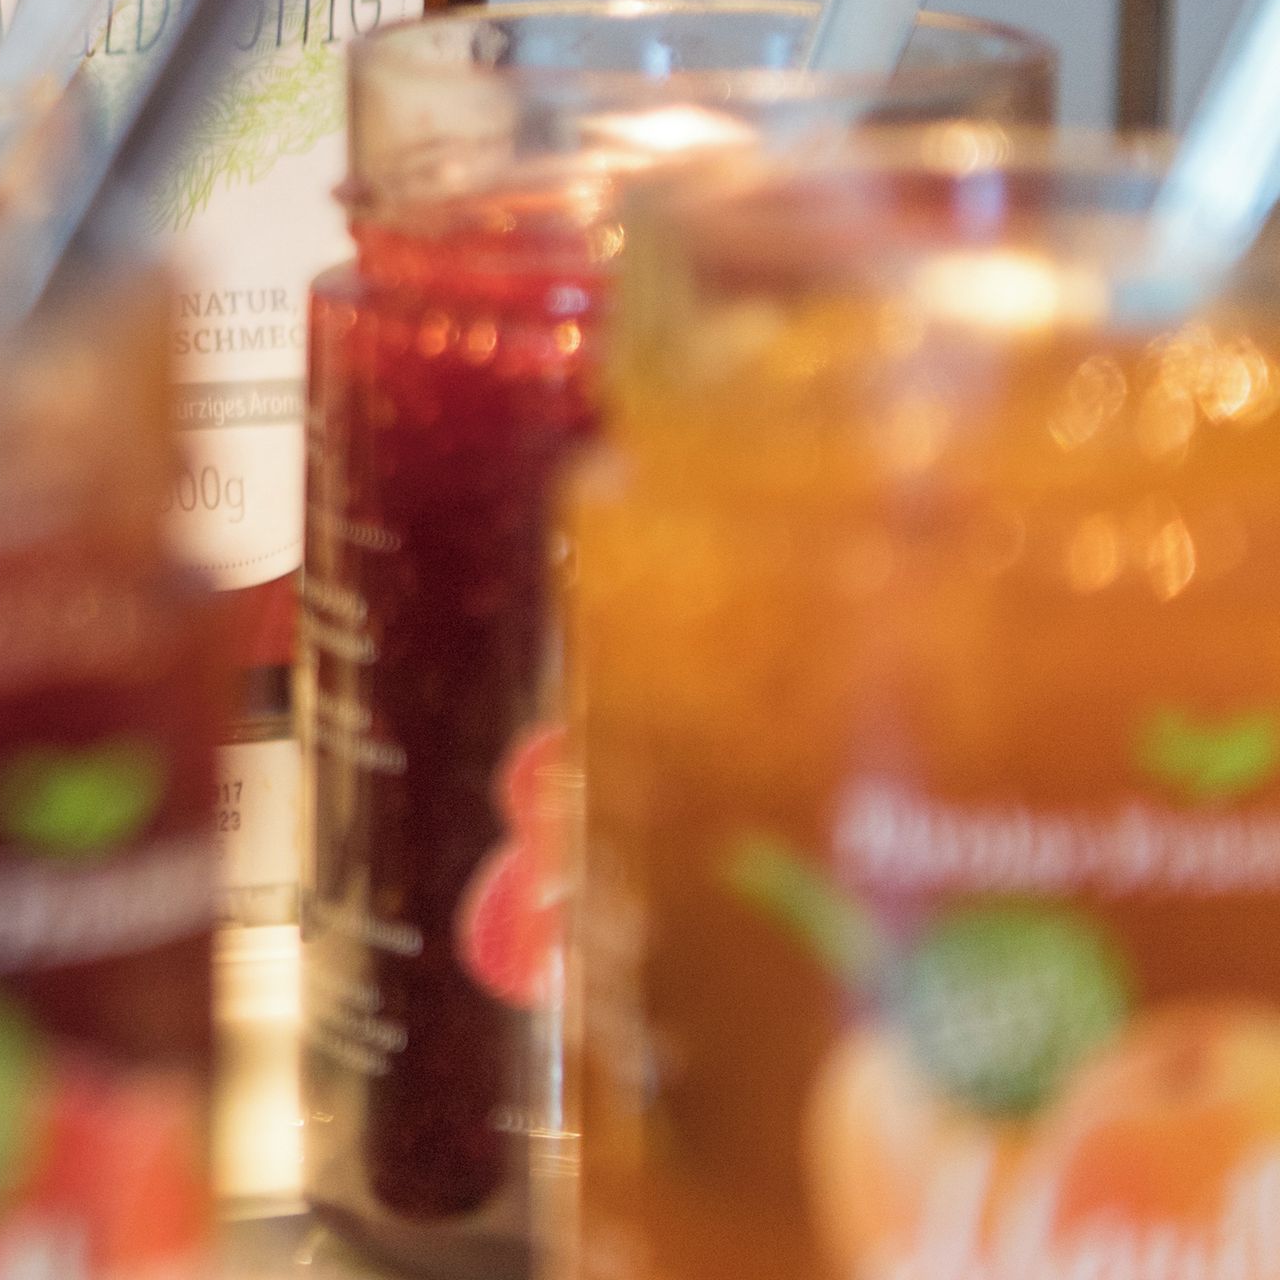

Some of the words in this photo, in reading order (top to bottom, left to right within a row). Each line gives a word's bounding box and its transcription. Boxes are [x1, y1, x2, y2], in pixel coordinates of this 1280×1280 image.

[175, 325, 306, 356] SCHMEC
[176, 396, 246, 427] ürziges
[164, 465, 247, 524] 00g
